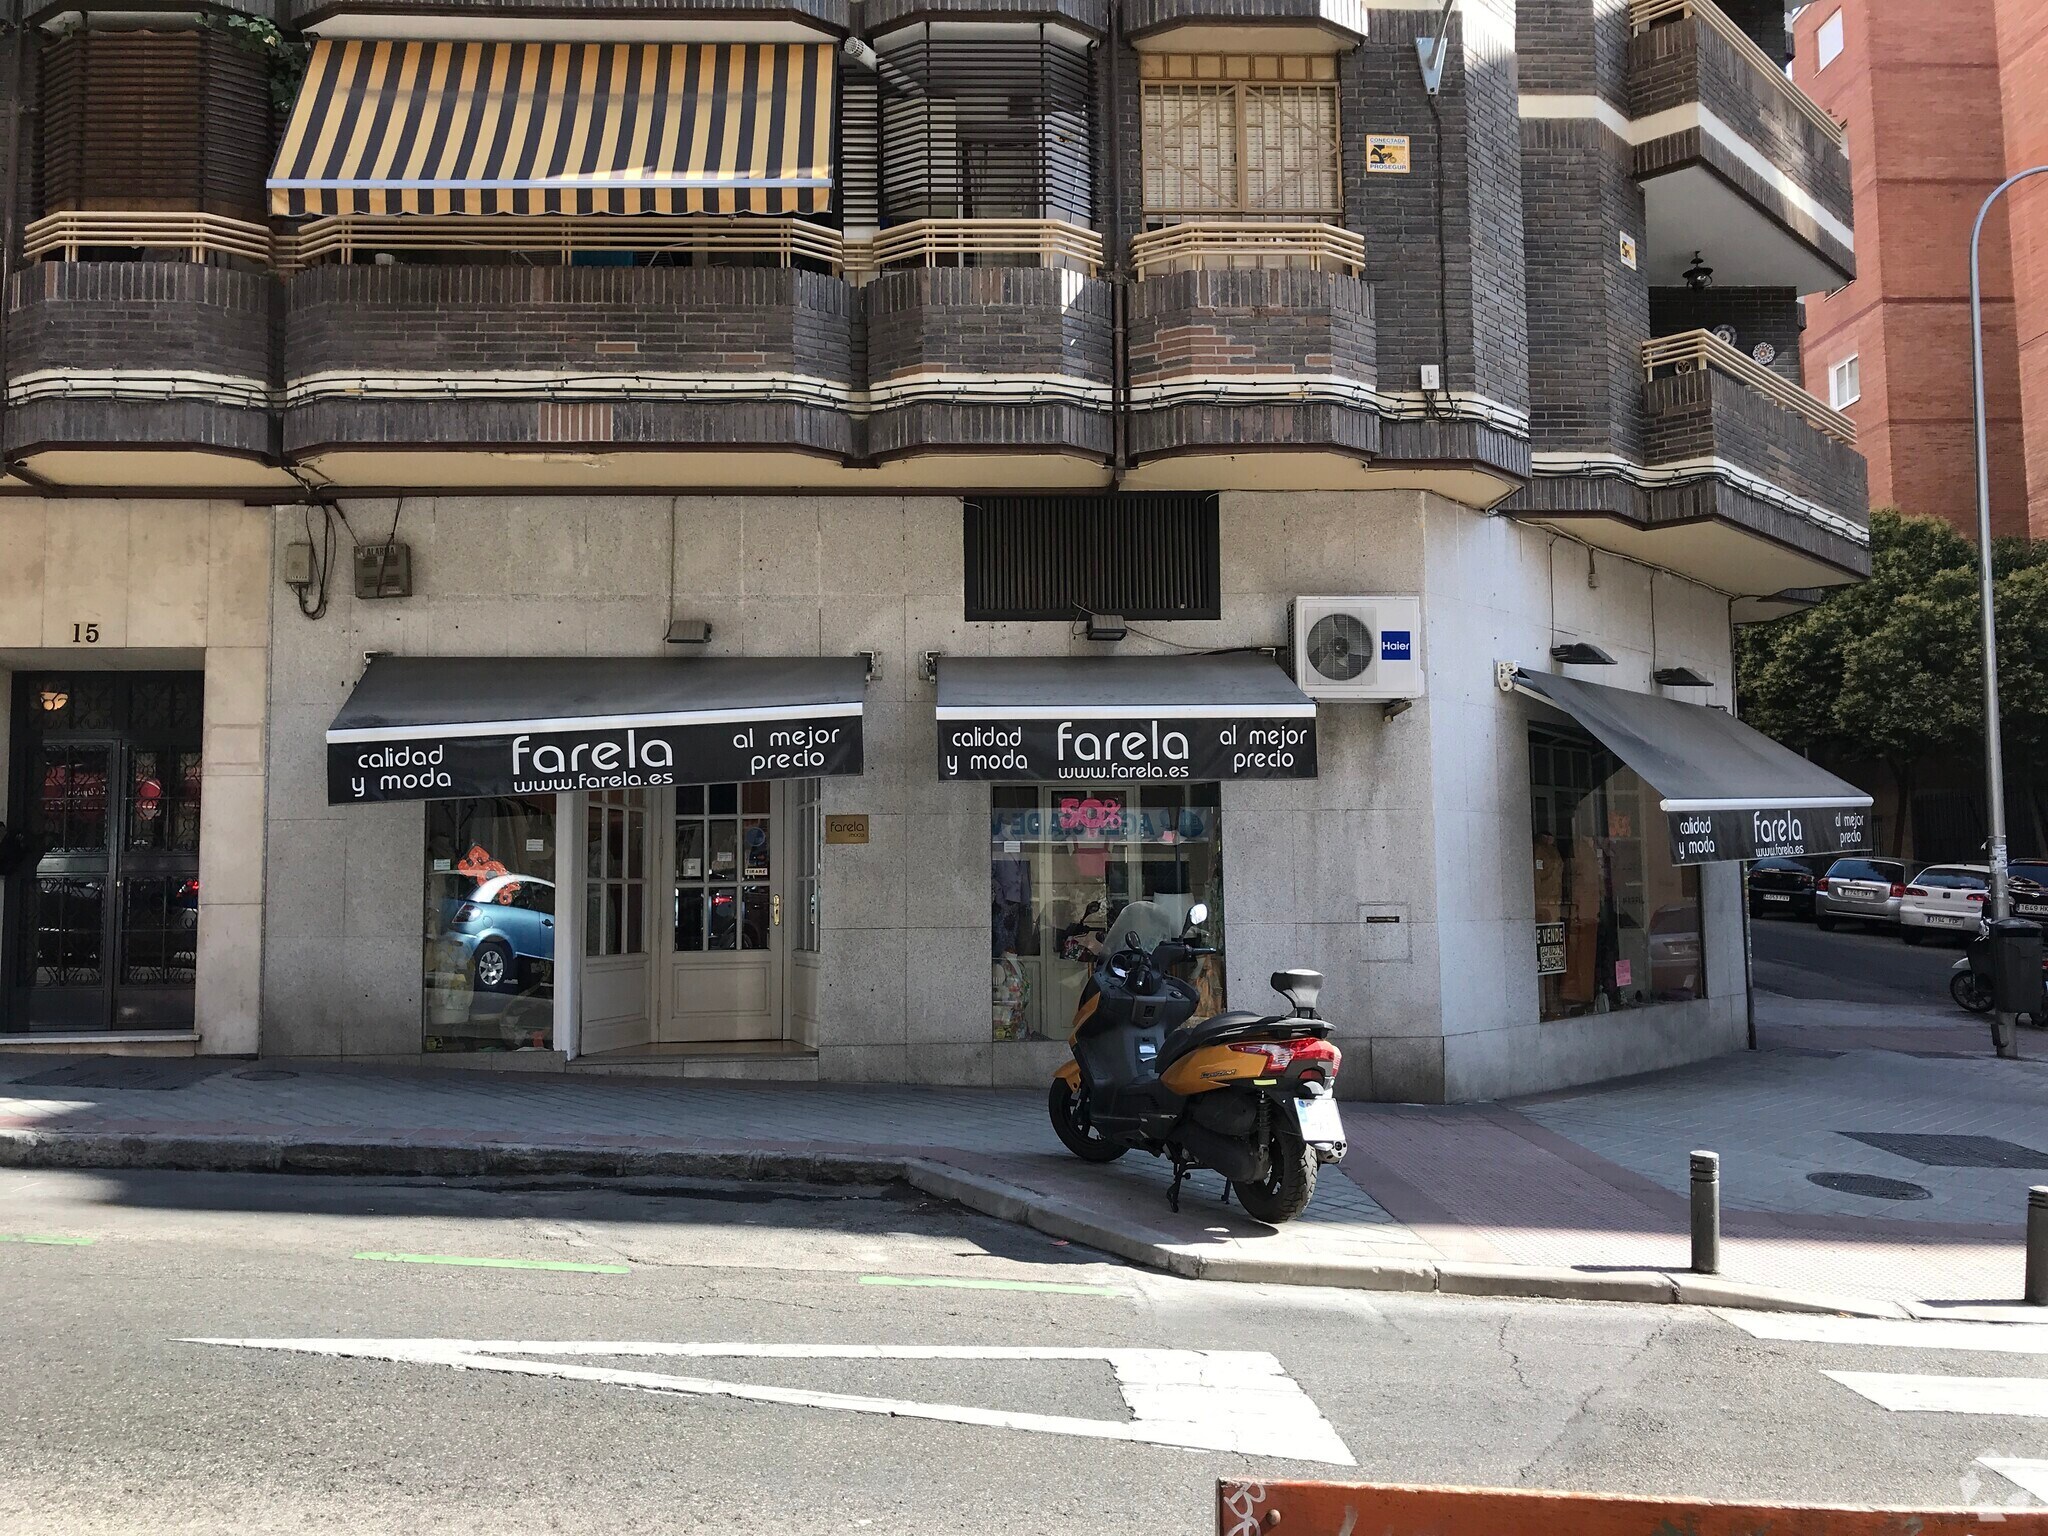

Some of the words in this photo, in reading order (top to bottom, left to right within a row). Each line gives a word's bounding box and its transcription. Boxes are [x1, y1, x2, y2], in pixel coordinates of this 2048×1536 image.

[367, 546, 395, 556] ALARA
[73, 623, 99, 643] 15
[1382, 641, 1410, 651] Haier
[733, 727, 754, 748] al
[769, 726, 840, 749] mejor
[952, 726, 1022, 747] calidad
[1057, 720, 1189, 761] farela
[1219, 724, 1236, 745] al
[1249, 725, 1308, 749] mejor
[358, 744, 443, 768] calidad
[512, 729, 673, 775] farela
[751, 749, 825, 775] precio
[947, 755, 958, 775] y
[970, 748, 1028, 769] moda
[1233, 749, 1294, 773] precio
[1058, 762, 1189, 779] www.farela.es
[351, 777, 365, 797] y
[380, 767, 452, 790] moda
[513, 771, 674, 793] www.farela.es
[1060, 797, 1122, 829] 50%
[1835, 814, 1841, 827] al
[1844, 813, 1864, 830] mejor
[830, 821, 865, 832] farela
[1679, 816, 1711, 835] calidad
[1754, 810, 1802, 843] farela
[1678, 842, 1686, 860] y
[1688, 835, 1715, 853] moda
[1840, 830, 1861, 847] precio
[1755, 843, 1804, 857] www.farela.es
[1542, 928, 1563, 943] VENDE
